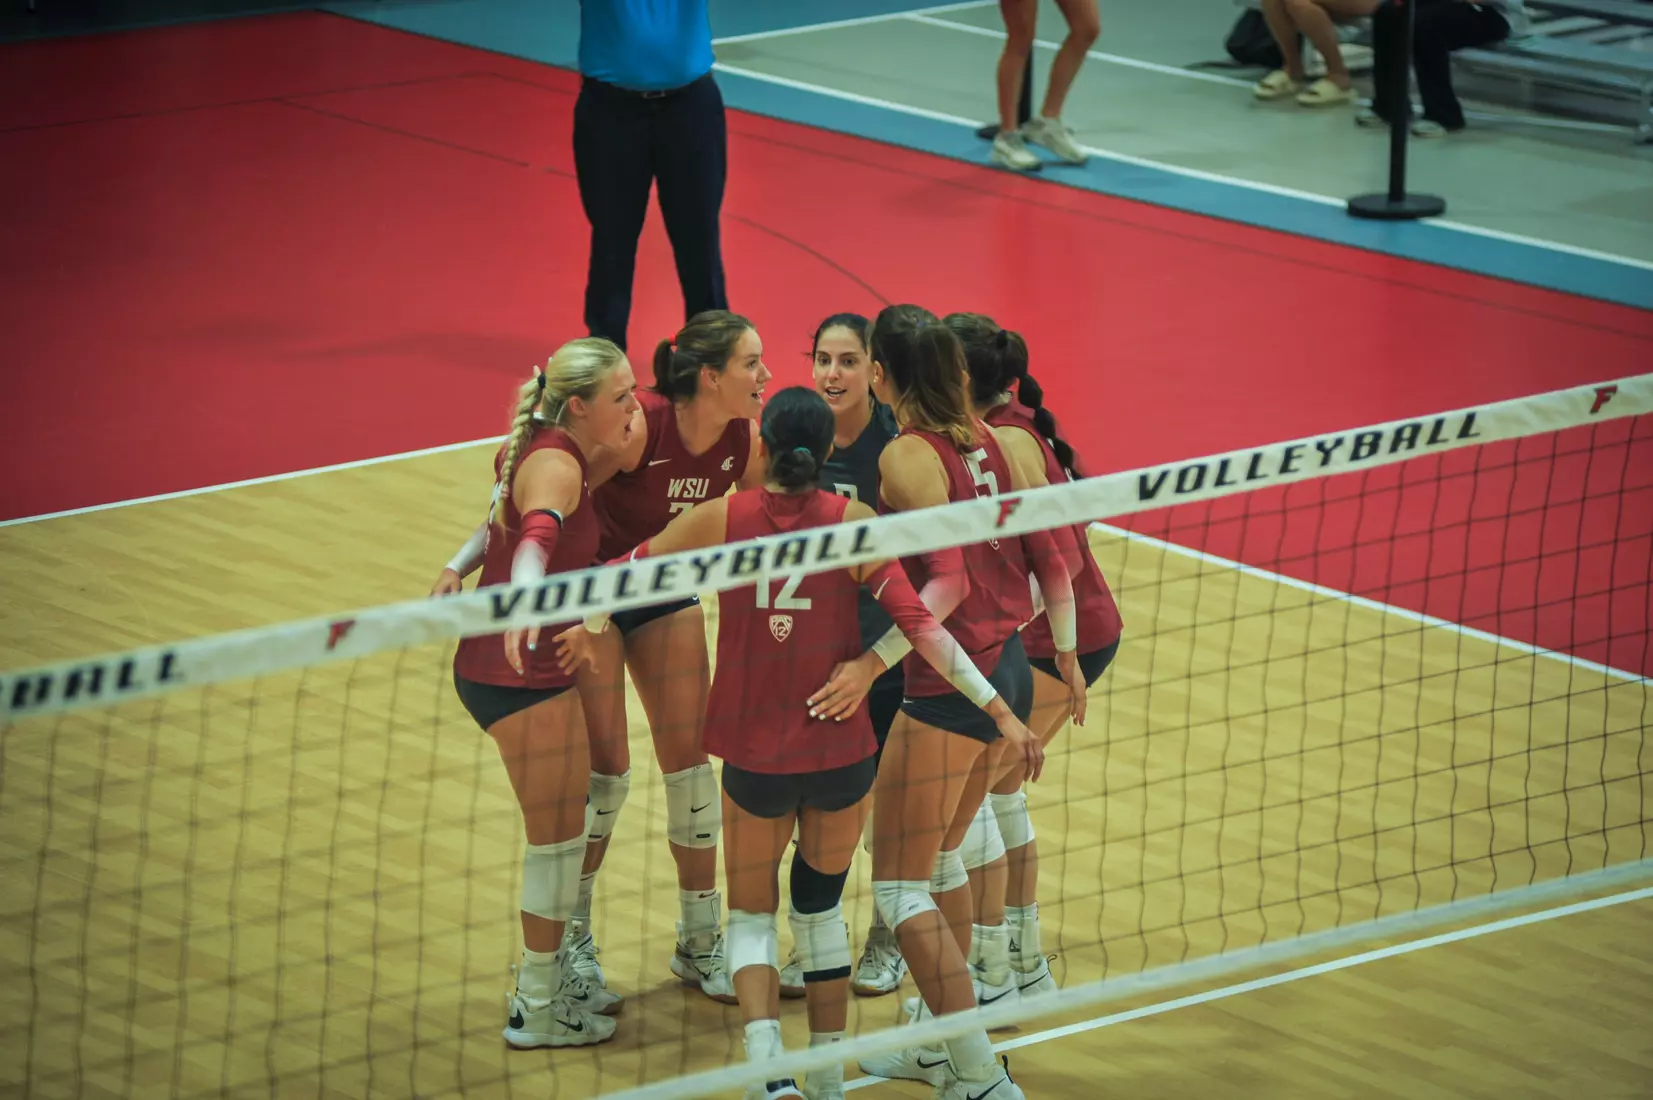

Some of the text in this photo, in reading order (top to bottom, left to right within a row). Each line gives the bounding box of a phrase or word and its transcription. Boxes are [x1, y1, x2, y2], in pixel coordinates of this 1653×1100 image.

[1137, 411, 1481, 502] VOLLEYBALL
[667, 477, 710, 498] WSU
[488, 524, 877, 623] VOLLEYBALL
[775, 626, 787, 636] 12
